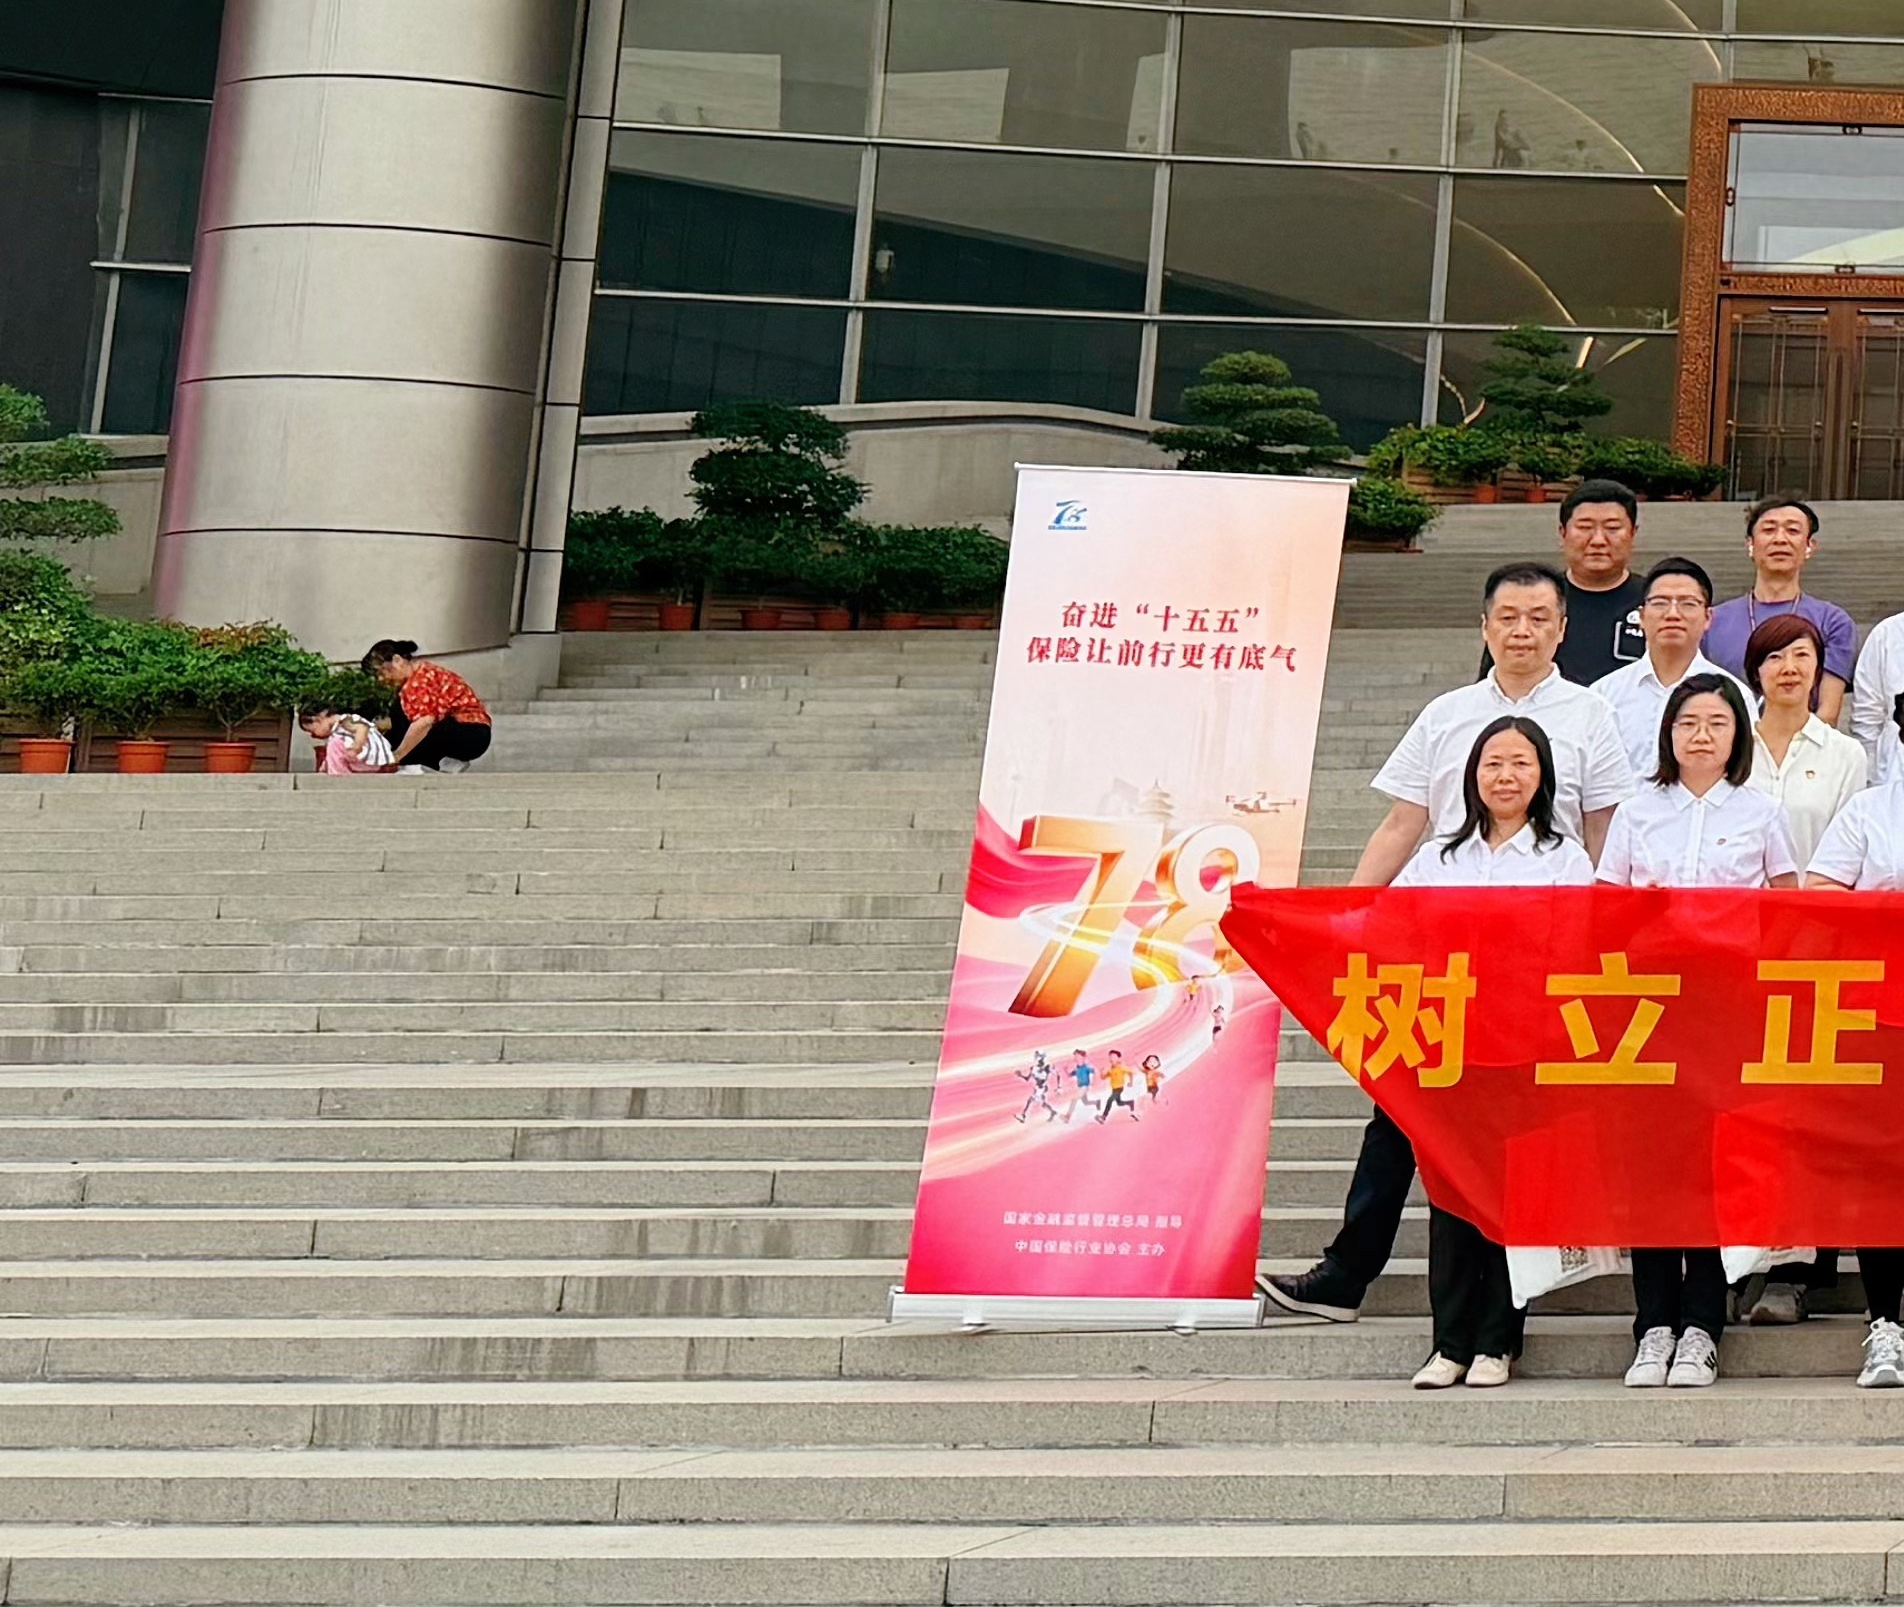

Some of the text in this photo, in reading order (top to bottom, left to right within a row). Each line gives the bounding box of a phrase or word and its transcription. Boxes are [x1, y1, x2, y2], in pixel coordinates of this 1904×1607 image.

[1026, 636, 1297, 672] 保险让前行更有底气
